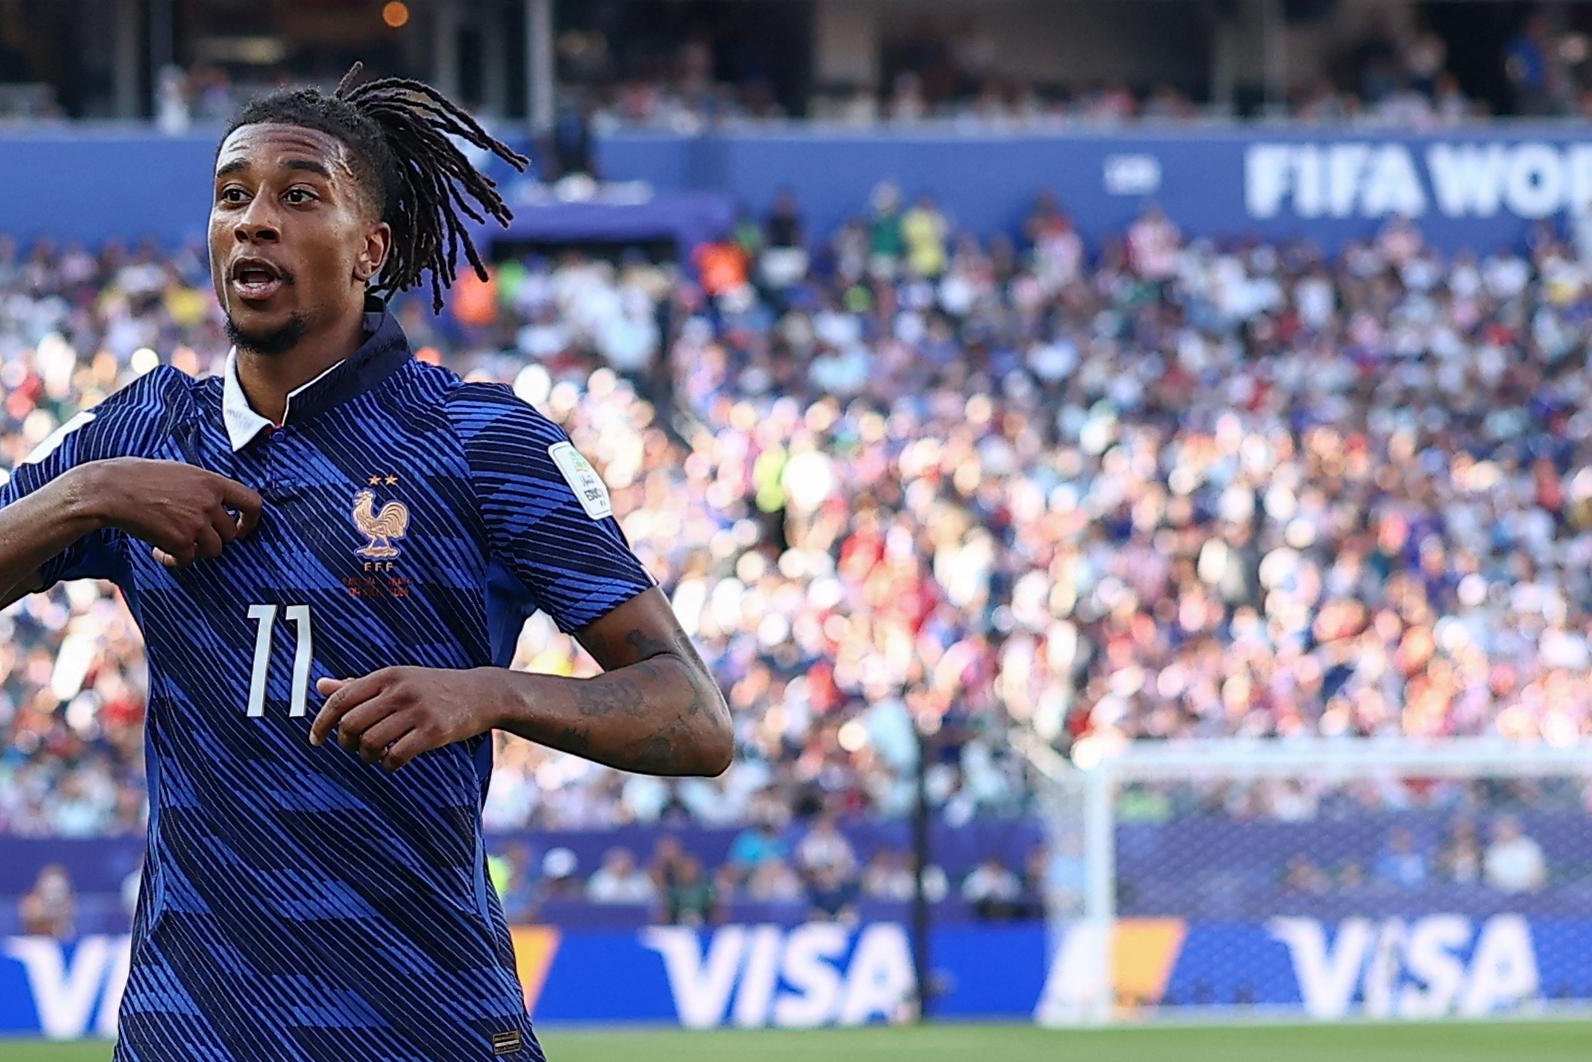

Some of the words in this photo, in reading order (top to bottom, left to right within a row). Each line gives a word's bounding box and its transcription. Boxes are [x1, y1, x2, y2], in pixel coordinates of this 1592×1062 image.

[1244, 142, 1426, 218] FIFA
[364, 562, 394, 572] FFF
[246, 604, 312, 717] 11
[639, 921, 921, 1029] VISA
[1266, 912, 1546, 1019] VISA
